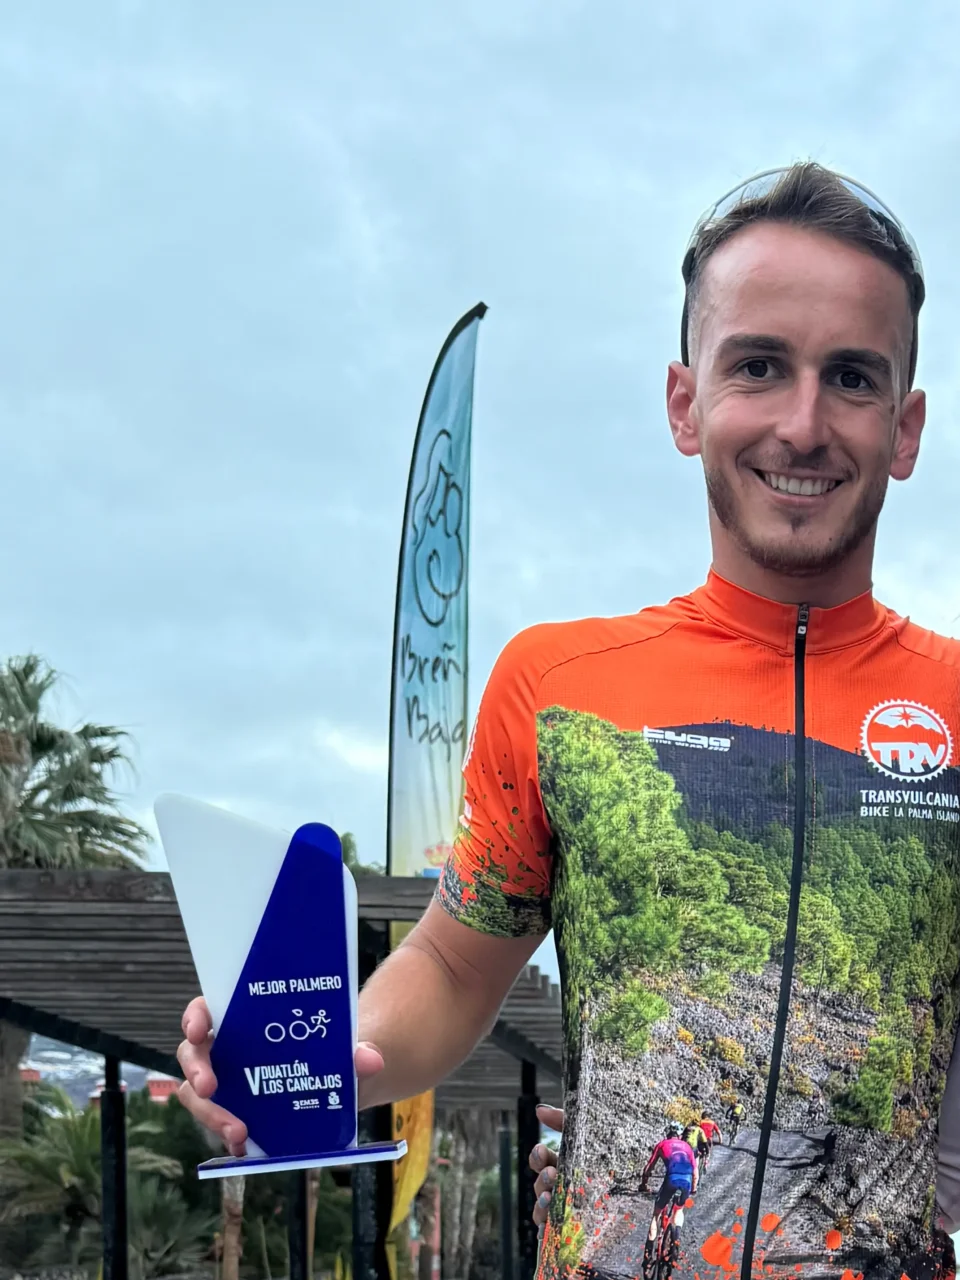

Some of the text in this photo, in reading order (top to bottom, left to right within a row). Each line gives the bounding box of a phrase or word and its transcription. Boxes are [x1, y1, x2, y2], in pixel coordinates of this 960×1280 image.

[401, 633, 466, 685] Breñ
[405, 694, 465, 763] Baja
[860, 790, 960, 809] TRANSVULCANIA
[860, 806, 960, 823] BIKE LA PALMA ISLAND
[248, 975, 342, 996] MEJOR PALMERO
[243, 1059, 310, 1096] V DUATLÓN
[262, 1074, 342, 1095] LOS CANCAJOS
